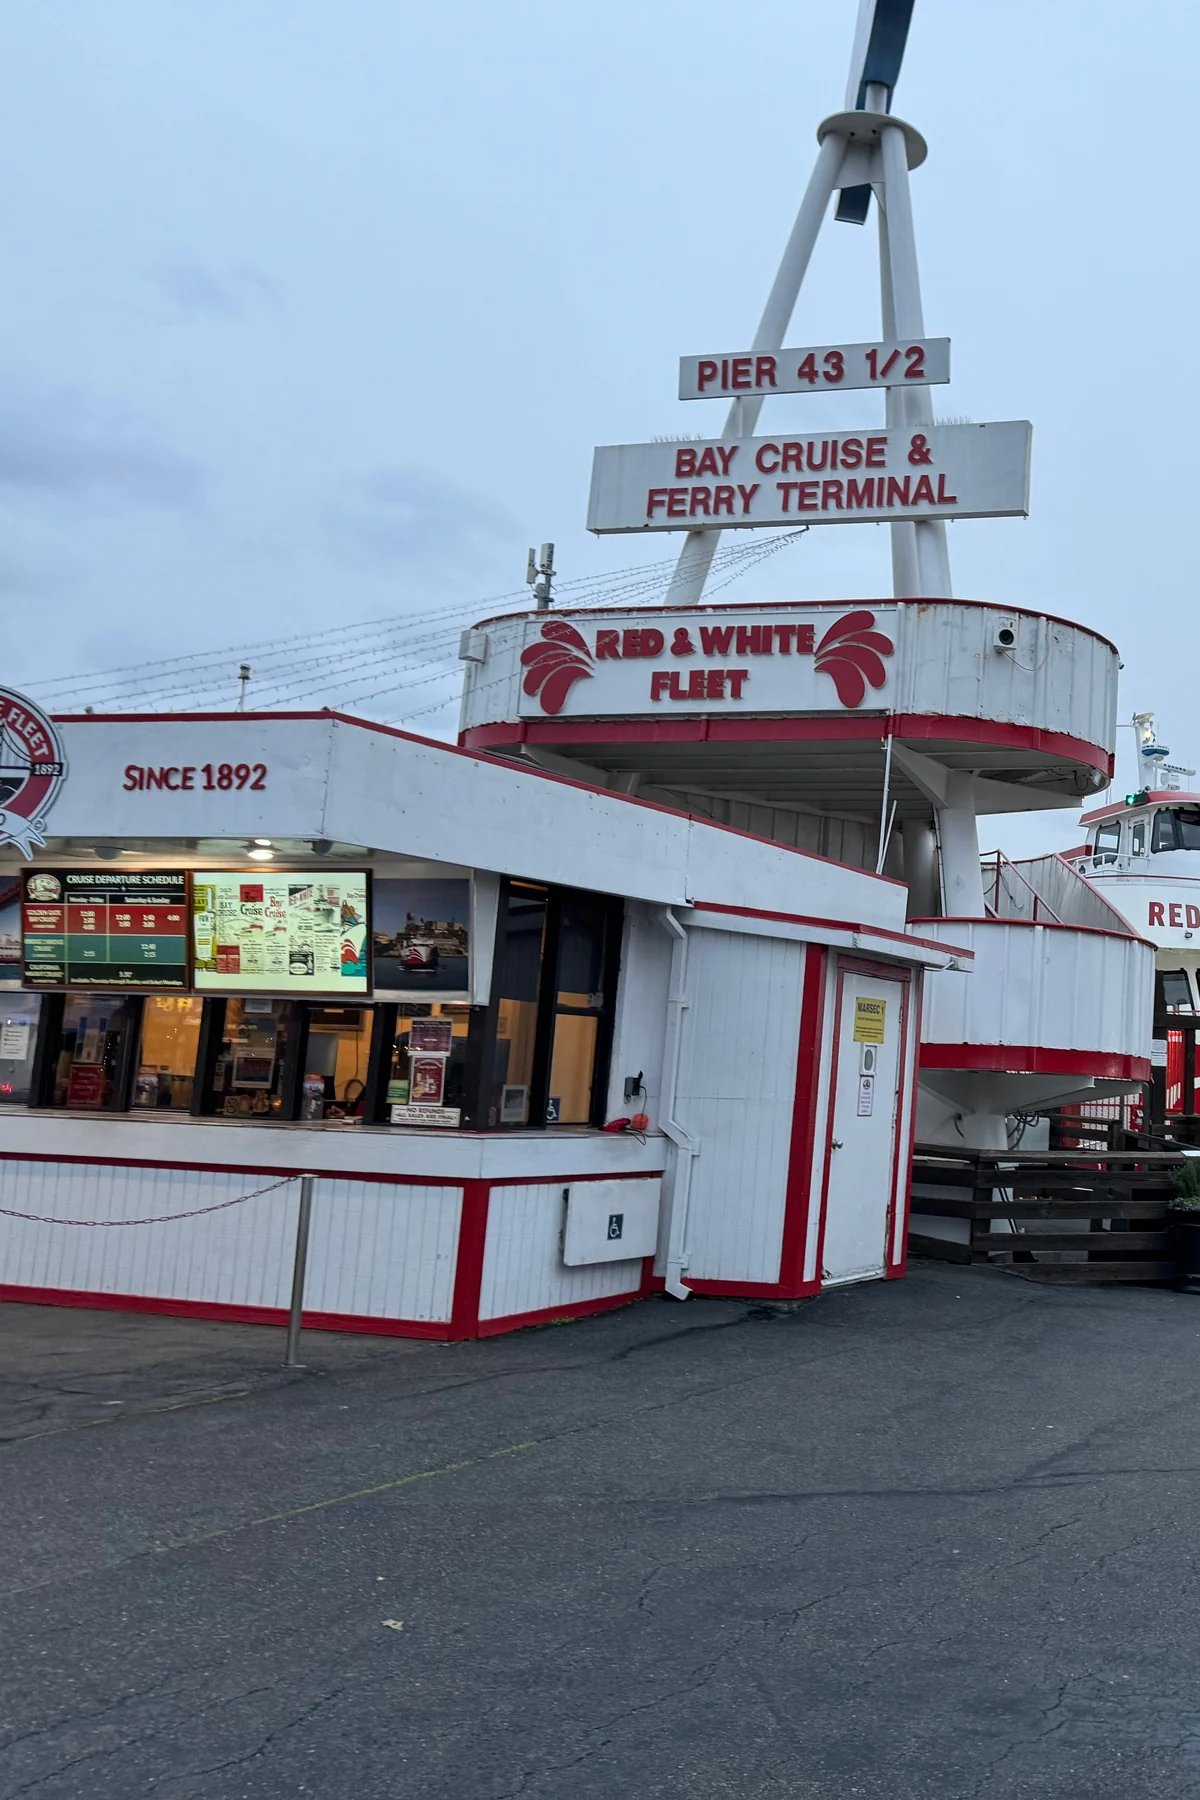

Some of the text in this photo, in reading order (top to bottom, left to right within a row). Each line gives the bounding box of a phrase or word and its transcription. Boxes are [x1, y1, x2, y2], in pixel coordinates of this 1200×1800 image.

[699, 346, 925, 390] PIER 43 1/2
[675, 433, 934, 478] BAY CRUISE &
[647, 473, 958, 518] FERRY TERMINAL
[596, 624, 816, 659] RED & WHITE
[650, 669, 749, 701] FLEET
[7, 707, 50, 757] FLEET
[34, 764, 60, 775] 1892
[123, 763, 267, 791] SINCE 1892
[66, 875, 184, 885] CRUISE DEPARTURE SCHEDULE
[240, 904, 263, 916] Cruise
[265, 907, 287, 918] Cruise
[1148, 902, 1200, 929] RED
